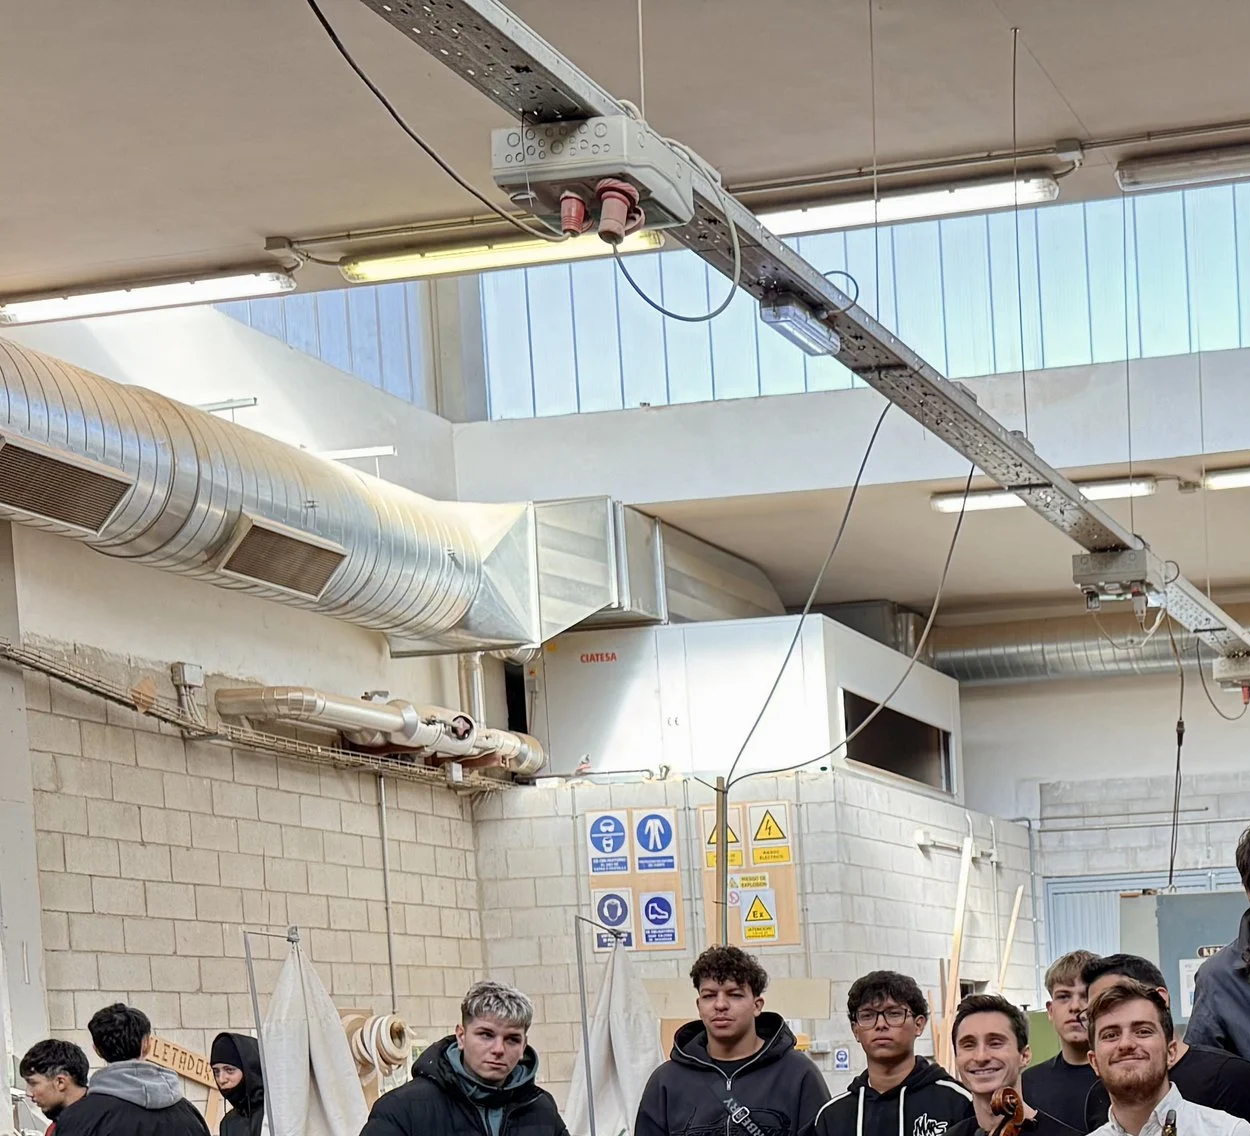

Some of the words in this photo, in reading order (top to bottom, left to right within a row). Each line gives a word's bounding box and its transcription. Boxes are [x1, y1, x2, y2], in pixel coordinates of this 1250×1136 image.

[580, 652, 617, 663] CIATESA
[752, 910, 765, 918] Ex
[150, 1036, 213, 1081] LETADOR
